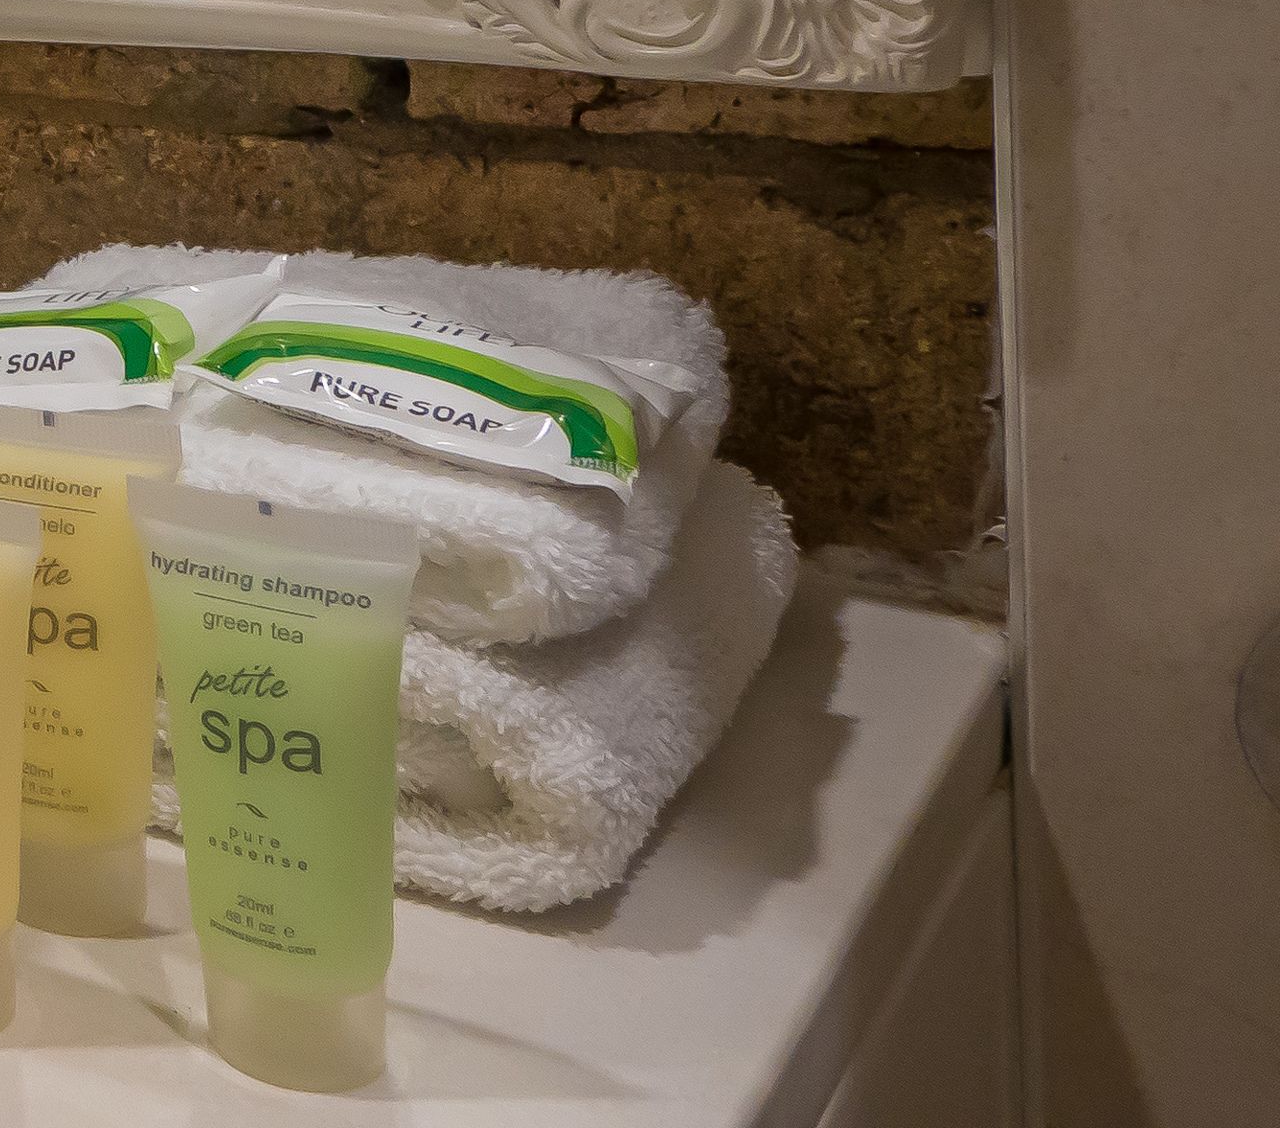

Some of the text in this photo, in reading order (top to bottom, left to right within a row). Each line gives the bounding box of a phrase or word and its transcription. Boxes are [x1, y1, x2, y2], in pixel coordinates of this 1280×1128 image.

[7, 349, 77, 375] SOAP
[310, 370, 505, 434] PURE SOAP
[33, 557, 72, 586] ite
[151, 551, 372, 610] hydrating shampoo
[27, 607, 100, 656] pa
[203, 611, 305, 644] green tea
[190, 665, 290, 704] petite
[28, 705, 61, 719] ure
[200, 710, 324, 776] spa
[208, 835, 308, 872] essense
[229, 826, 281, 849] pure
[236, 894, 275, 916] 20ml
